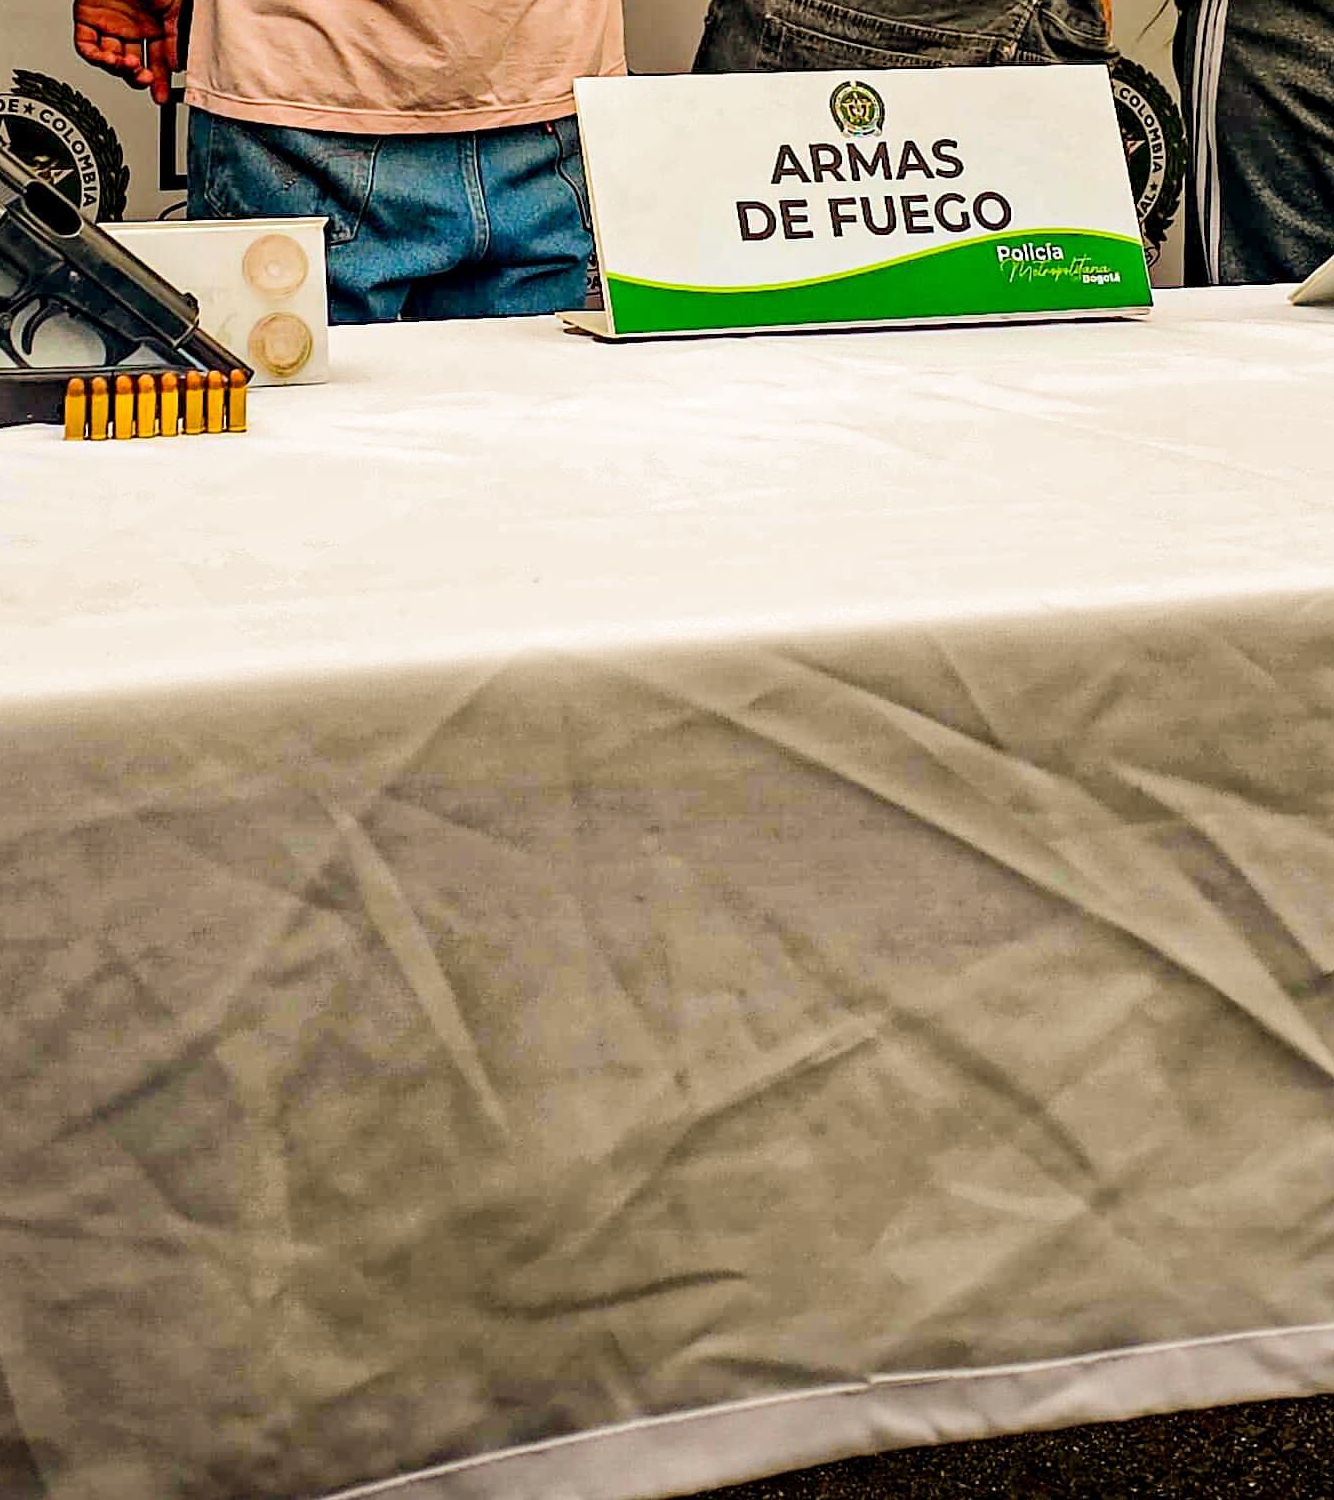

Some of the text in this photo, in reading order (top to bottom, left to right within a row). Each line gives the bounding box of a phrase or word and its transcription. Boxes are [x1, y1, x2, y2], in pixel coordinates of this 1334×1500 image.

[1119, 87, 1163, 173] COLOMBIA
[39, 109, 97, 207] COLOMBIA
[771, 139, 964, 184] ARMAS
[736, 192, 1011, 241] DE FUEGO
[997, 242, 1064, 262] Policía
